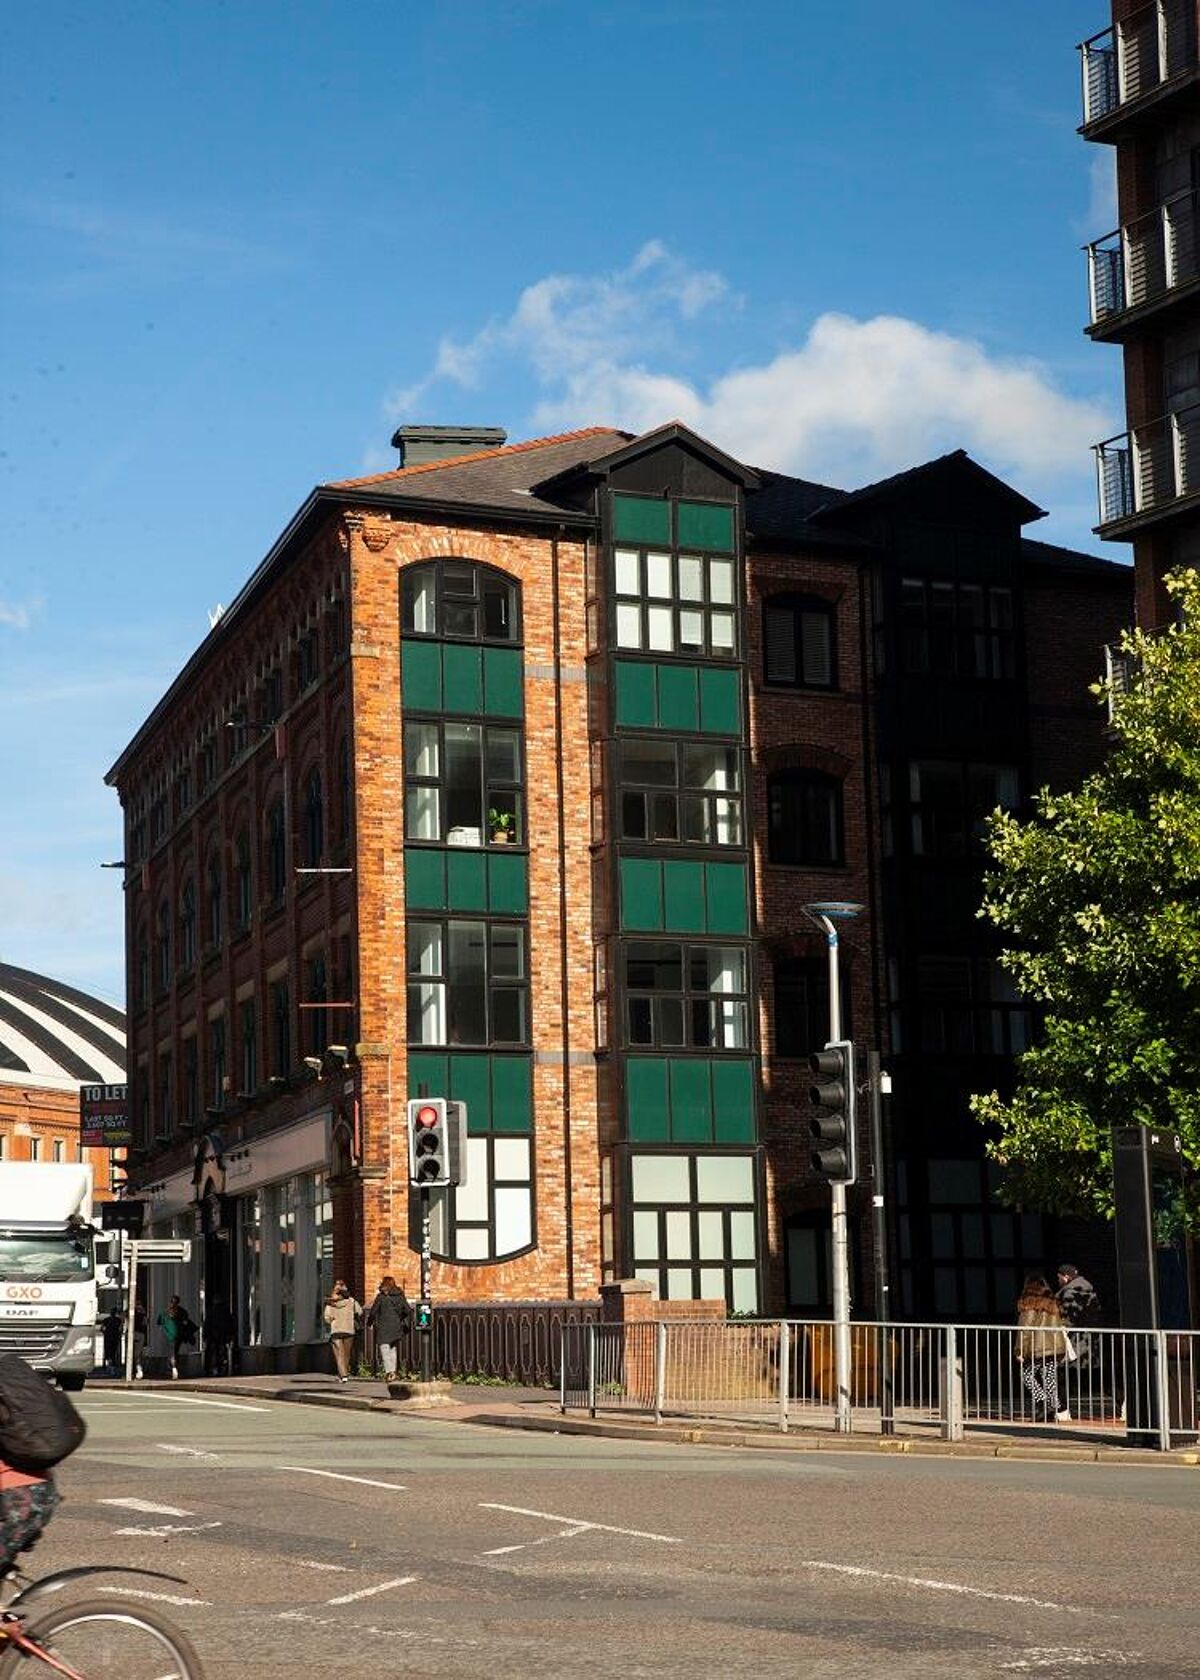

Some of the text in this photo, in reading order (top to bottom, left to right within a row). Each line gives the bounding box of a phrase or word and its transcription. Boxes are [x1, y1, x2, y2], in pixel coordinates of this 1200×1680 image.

[83, 1086, 129, 1101] TO LET
[6, 1286, 42, 1299] GXO
